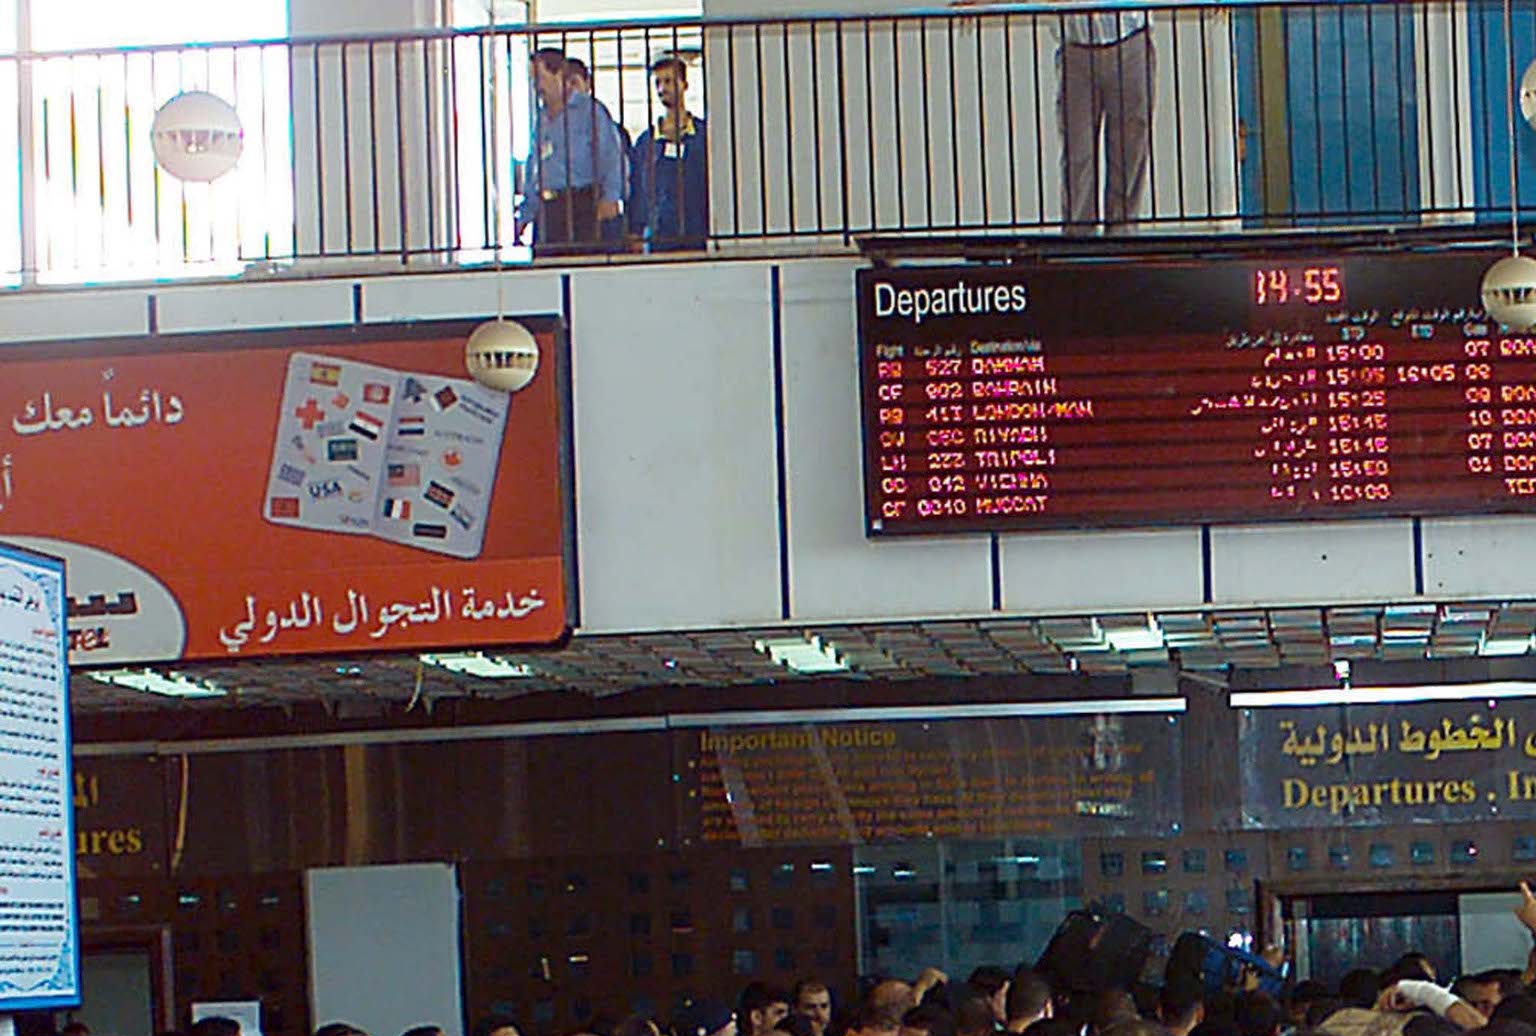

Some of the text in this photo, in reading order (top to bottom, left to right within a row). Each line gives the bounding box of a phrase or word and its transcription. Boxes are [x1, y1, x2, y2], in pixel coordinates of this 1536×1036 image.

[874, 281, 1027, 323] Departures
[12, 392, 93, 436] معك
[219, 583, 546, 652] خدمة التجوال الدولي
[821, 727, 896, 750] Notice
[1280, 716, 1389, 765] الدولية
[1398, 713, 1516, 761] الخطوط
[1282, 775, 1476, 817] Departures
